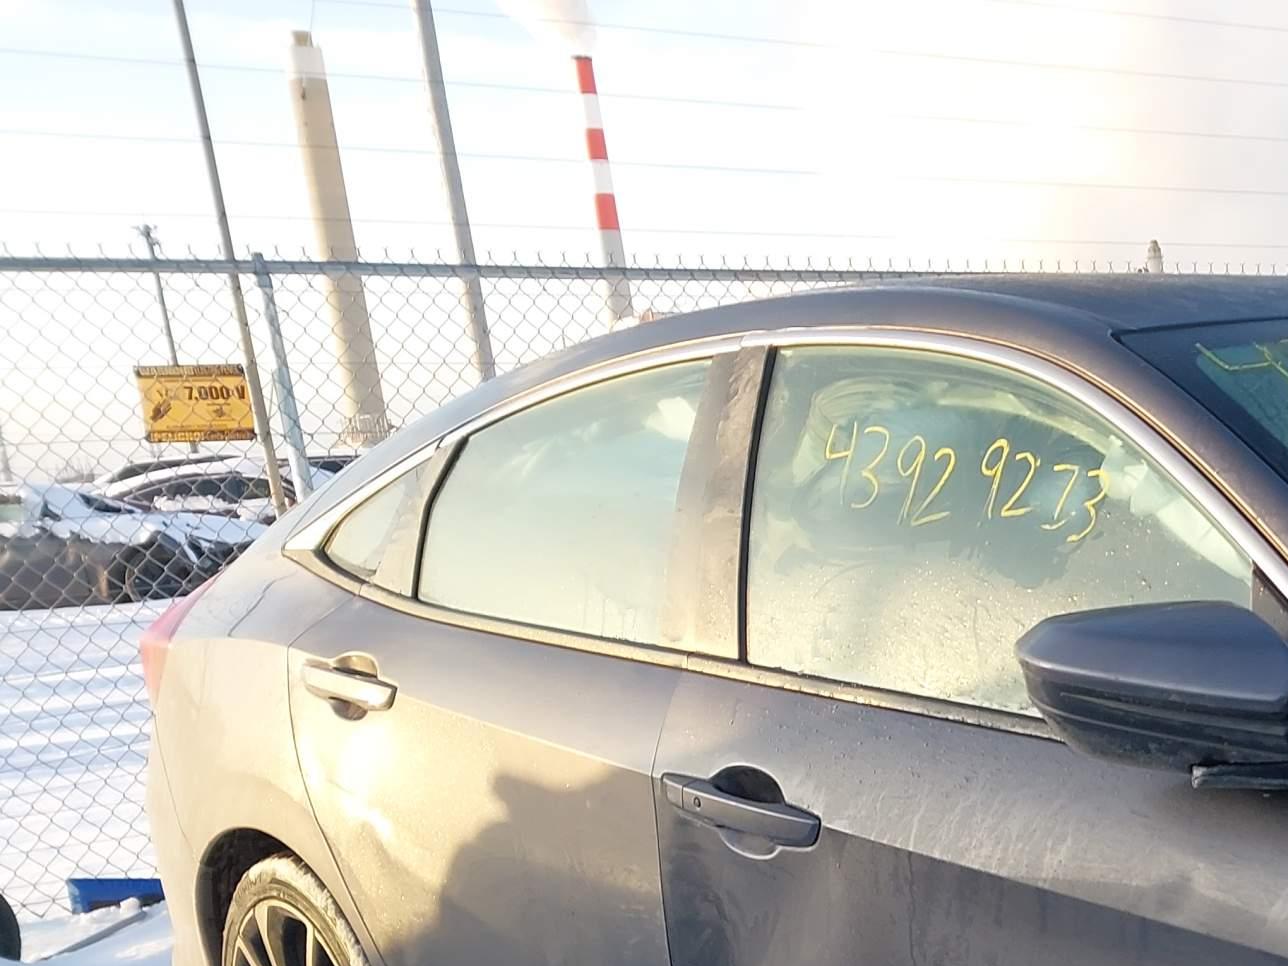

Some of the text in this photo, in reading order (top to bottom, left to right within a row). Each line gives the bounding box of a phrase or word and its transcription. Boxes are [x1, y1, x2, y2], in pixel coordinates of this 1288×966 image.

[183, 384, 246, 401] 7,000 V
[824, 421, 1110, 543] 4392 9273
